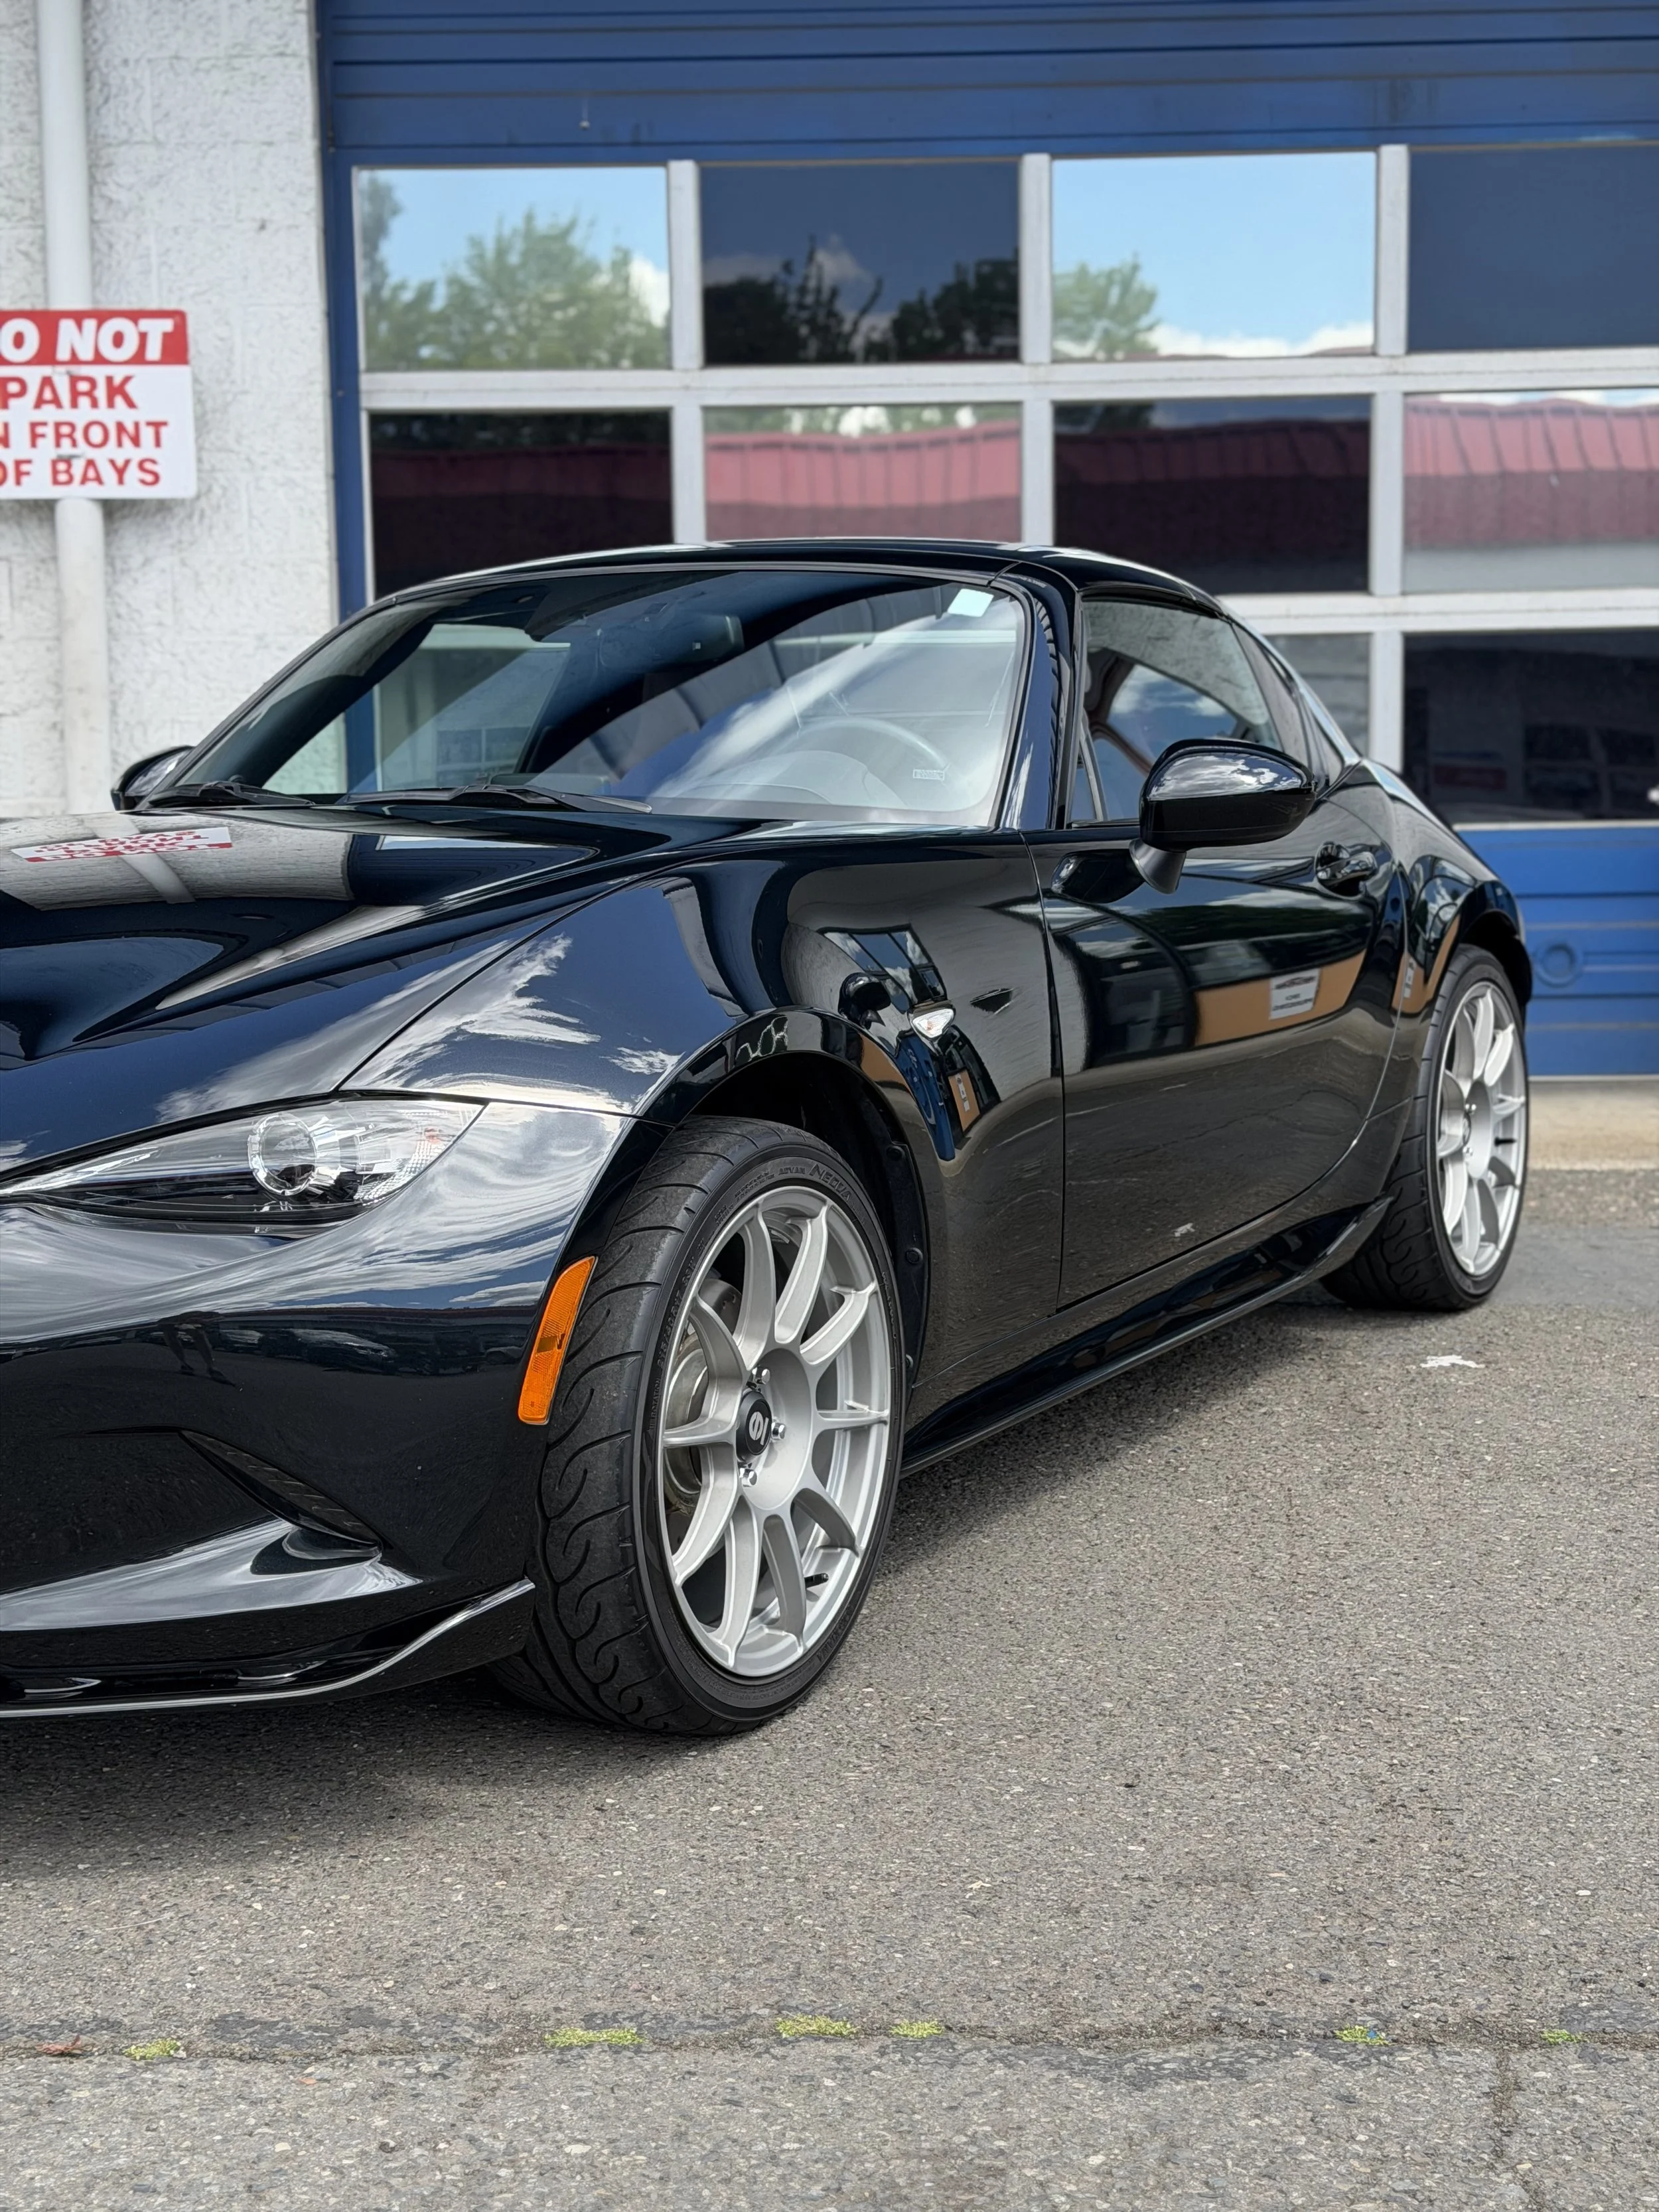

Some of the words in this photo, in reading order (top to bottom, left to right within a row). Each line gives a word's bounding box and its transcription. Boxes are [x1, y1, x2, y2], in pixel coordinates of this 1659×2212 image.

[0, 317, 40, 363] O
[55, 317, 175, 362] NOT
[0, 374, 138, 409] PARK
[29, 421, 169, 449] FRONT
[0, 458, 33, 487] F
[50, 457, 161, 486] BAYS
[808, 1163, 851, 1201] NEOVA
